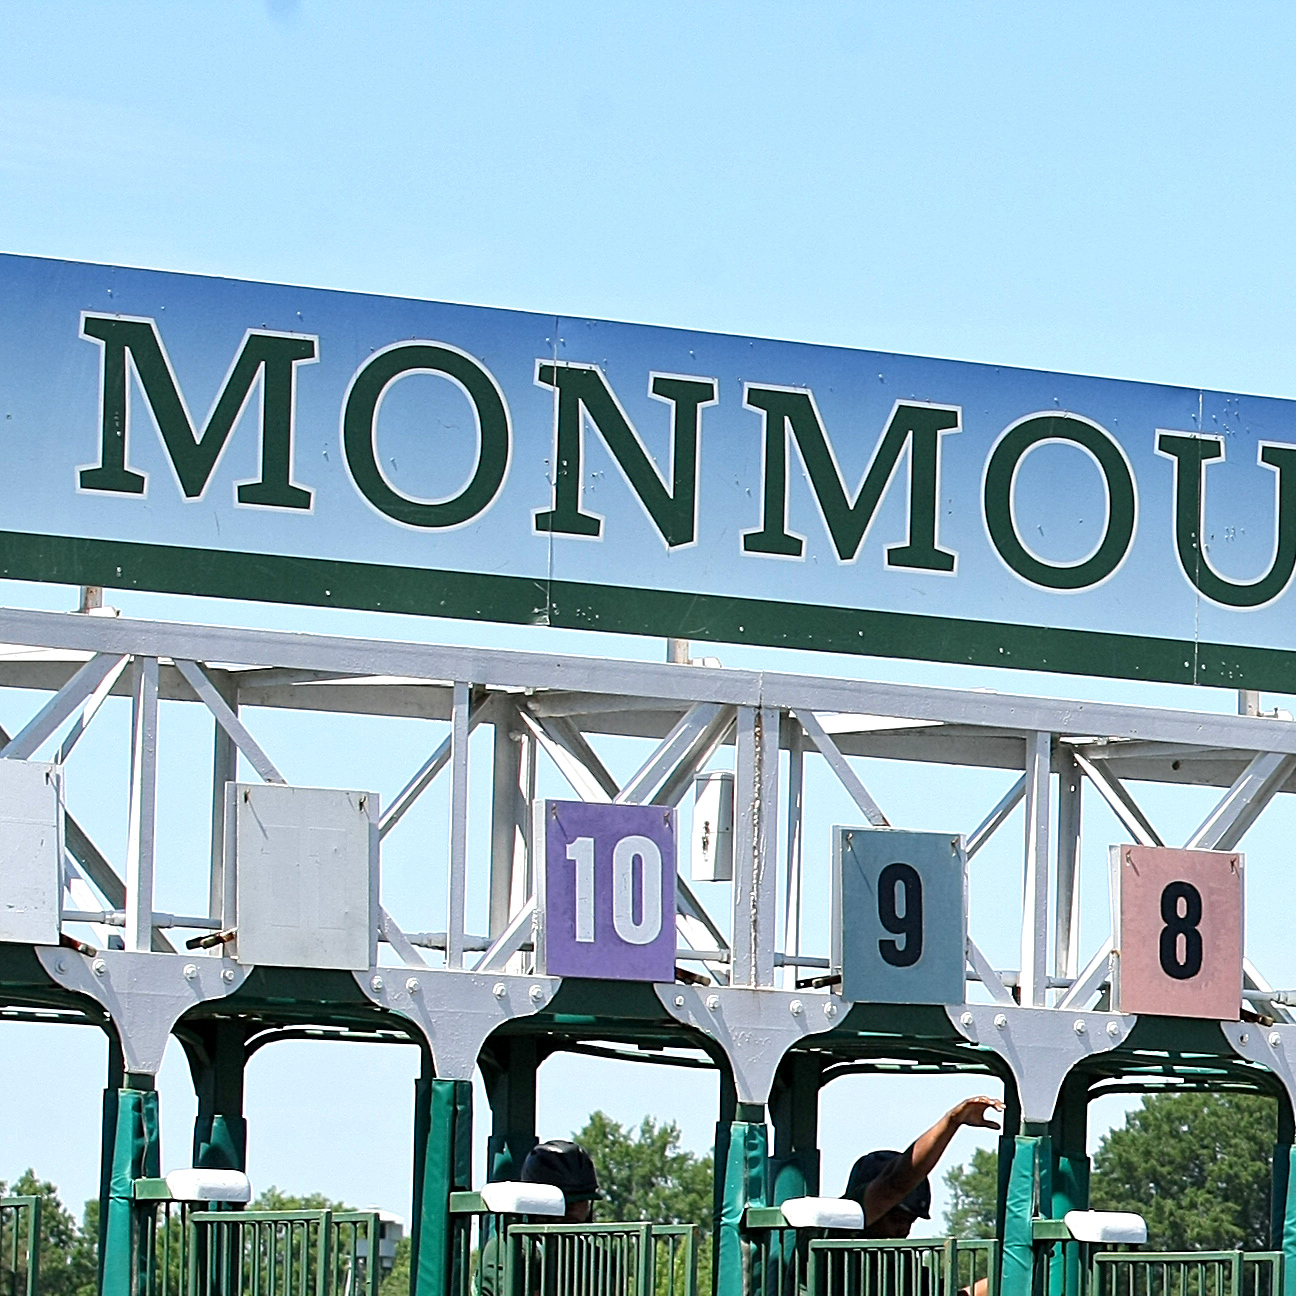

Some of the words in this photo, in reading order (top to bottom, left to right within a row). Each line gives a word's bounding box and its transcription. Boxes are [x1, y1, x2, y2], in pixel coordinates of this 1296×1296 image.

[565, 834, 663, 945] 10
[877, 862, 924, 968] 9
[1159, 880, 1203, 980] 8
